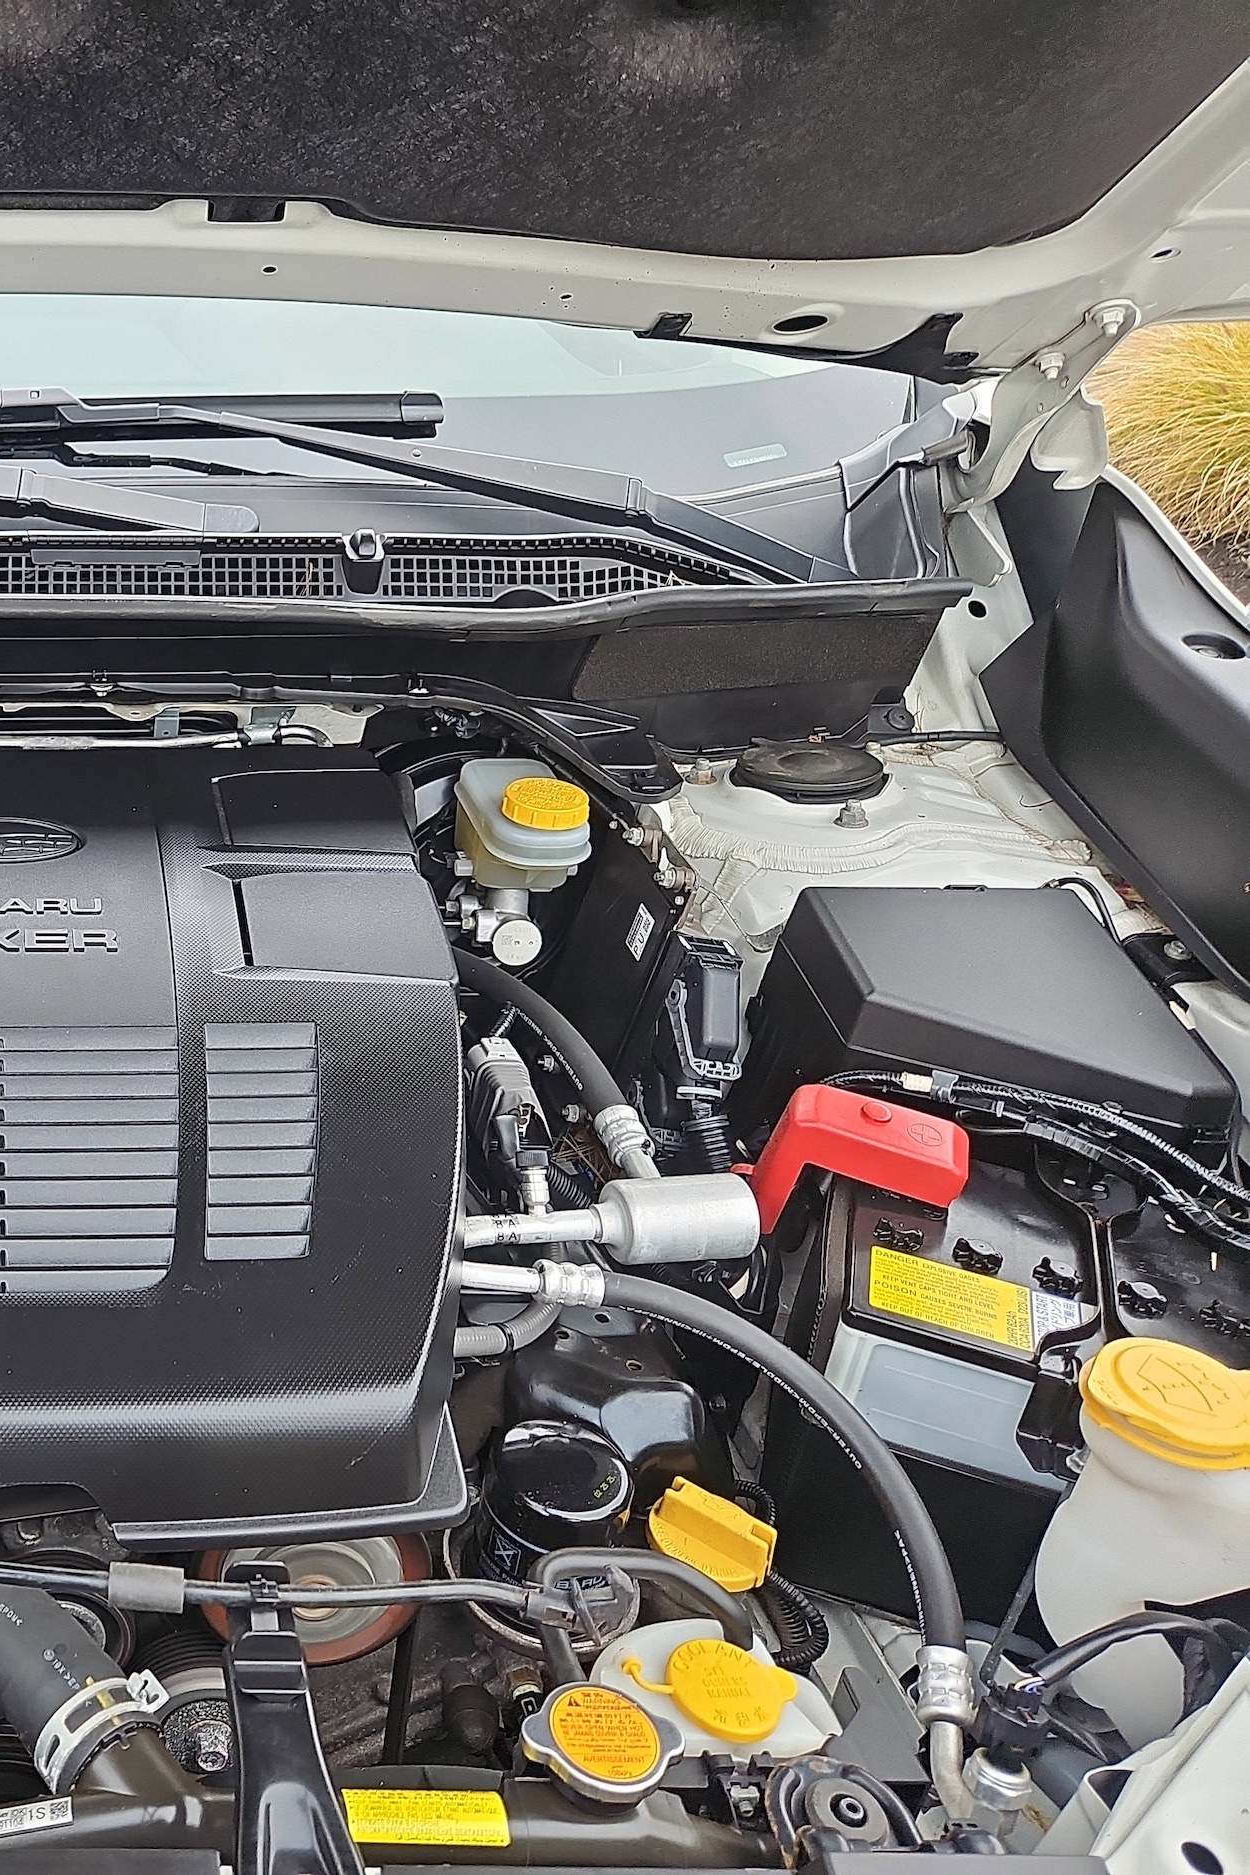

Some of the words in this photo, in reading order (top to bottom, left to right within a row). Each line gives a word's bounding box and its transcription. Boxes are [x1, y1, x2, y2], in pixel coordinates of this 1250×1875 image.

[875, 1249, 919, 1266] DANGER
[922, 1262, 957, 1278] EXPLOSIVE
[958, 1272, 981, 1283] GASES
[874, 1280, 917, 1297] POISON
[920, 1293, 946, 1305] CAUSES
[948, 1300, 973, 1313] SEVERE
[975, 1309, 998, 1320] BURNS
[882, 1274, 899, 1284] KEEP
[900, 1279, 918, 1289] VENT
[919, 1284, 936, 1294] CAPS
[938, 1290, 957, 1300] TIGHT
[959, 1296, 973, 1304] AND
[974, 1300, 995, 1311] LEVEL
[1035, 1294, 1049, 1316] START
[881, 1302, 898, 1312] KEEP
[899, 1306, 913, 1315] OUT
[915, 1310, 924, 1318] OF
[925, 1313, 948, 1326] REACH
[950, 1320, 959, 1328] OF
[960, 1323, 995, 1339] CHILDREN
[673, 1642, 756, 1672] COOLANT
